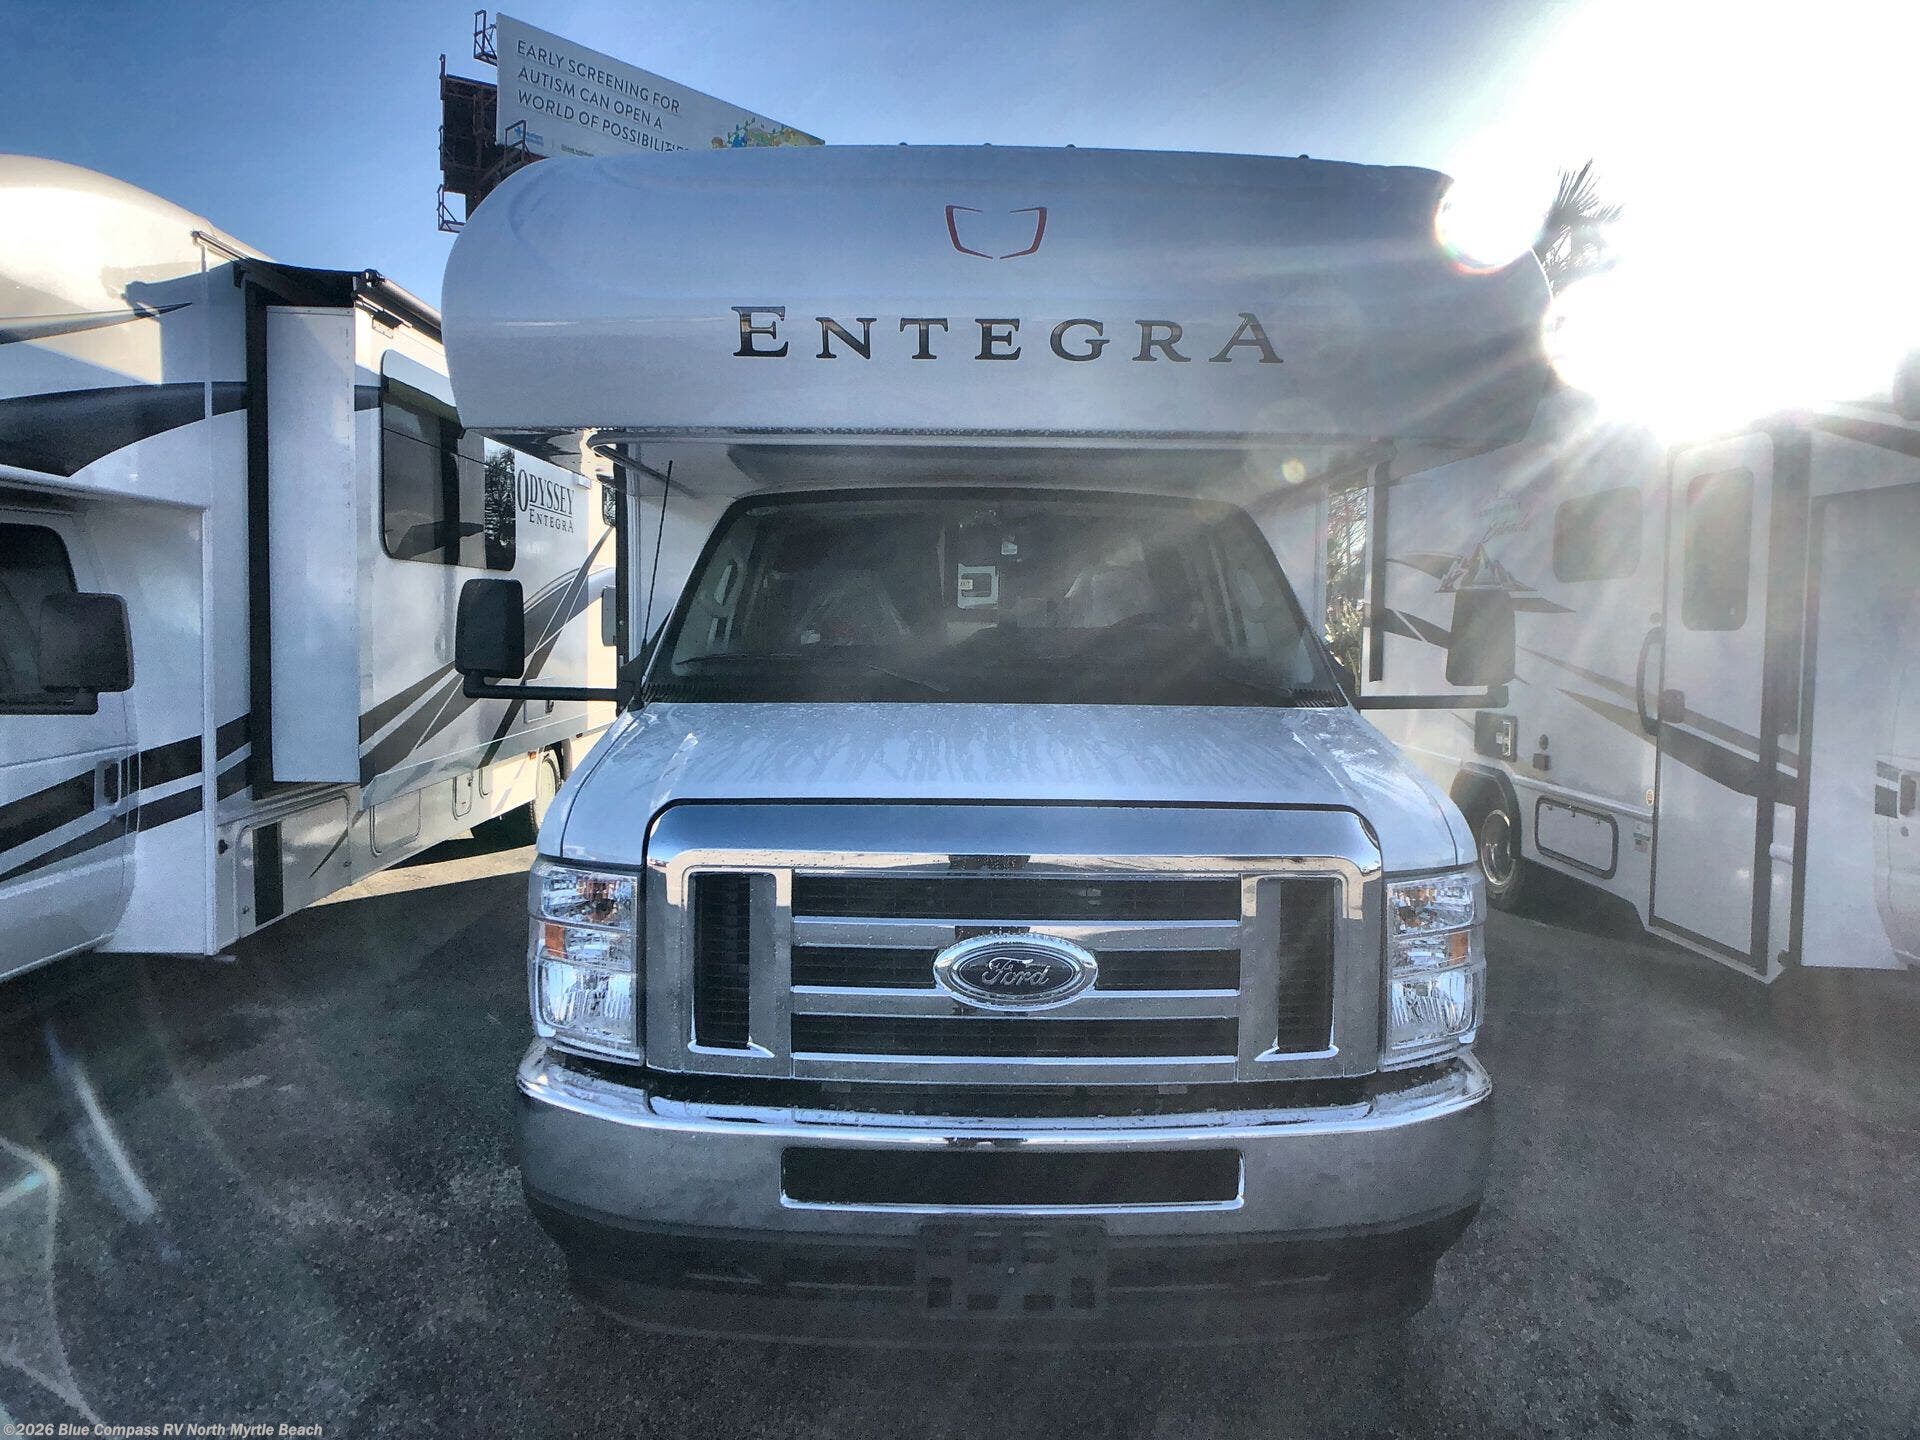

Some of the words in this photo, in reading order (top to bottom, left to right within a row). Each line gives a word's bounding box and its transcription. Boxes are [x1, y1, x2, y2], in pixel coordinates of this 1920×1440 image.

[517, 39, 564, 69] EARLY
[568, 59, 649, 101] SCREENING
[653, 92, 680, 113] FOR
[518, 65, 575, 97] AUTISM
[580, 87, 610, 110] CAN
[614, 100, 651, 125] OPEN
[653, 116, 663, 130] A
[518, 89, 574, 119] WORLD
[579, 111, 599, 128] OF
[731, 305, 1284, 363] ENTEGRA
[517, 469, 574, 514] ODYSSEY
[529, 508, 574, 533] ENTEGRA
[982, 957, 1050, 985] Ford
